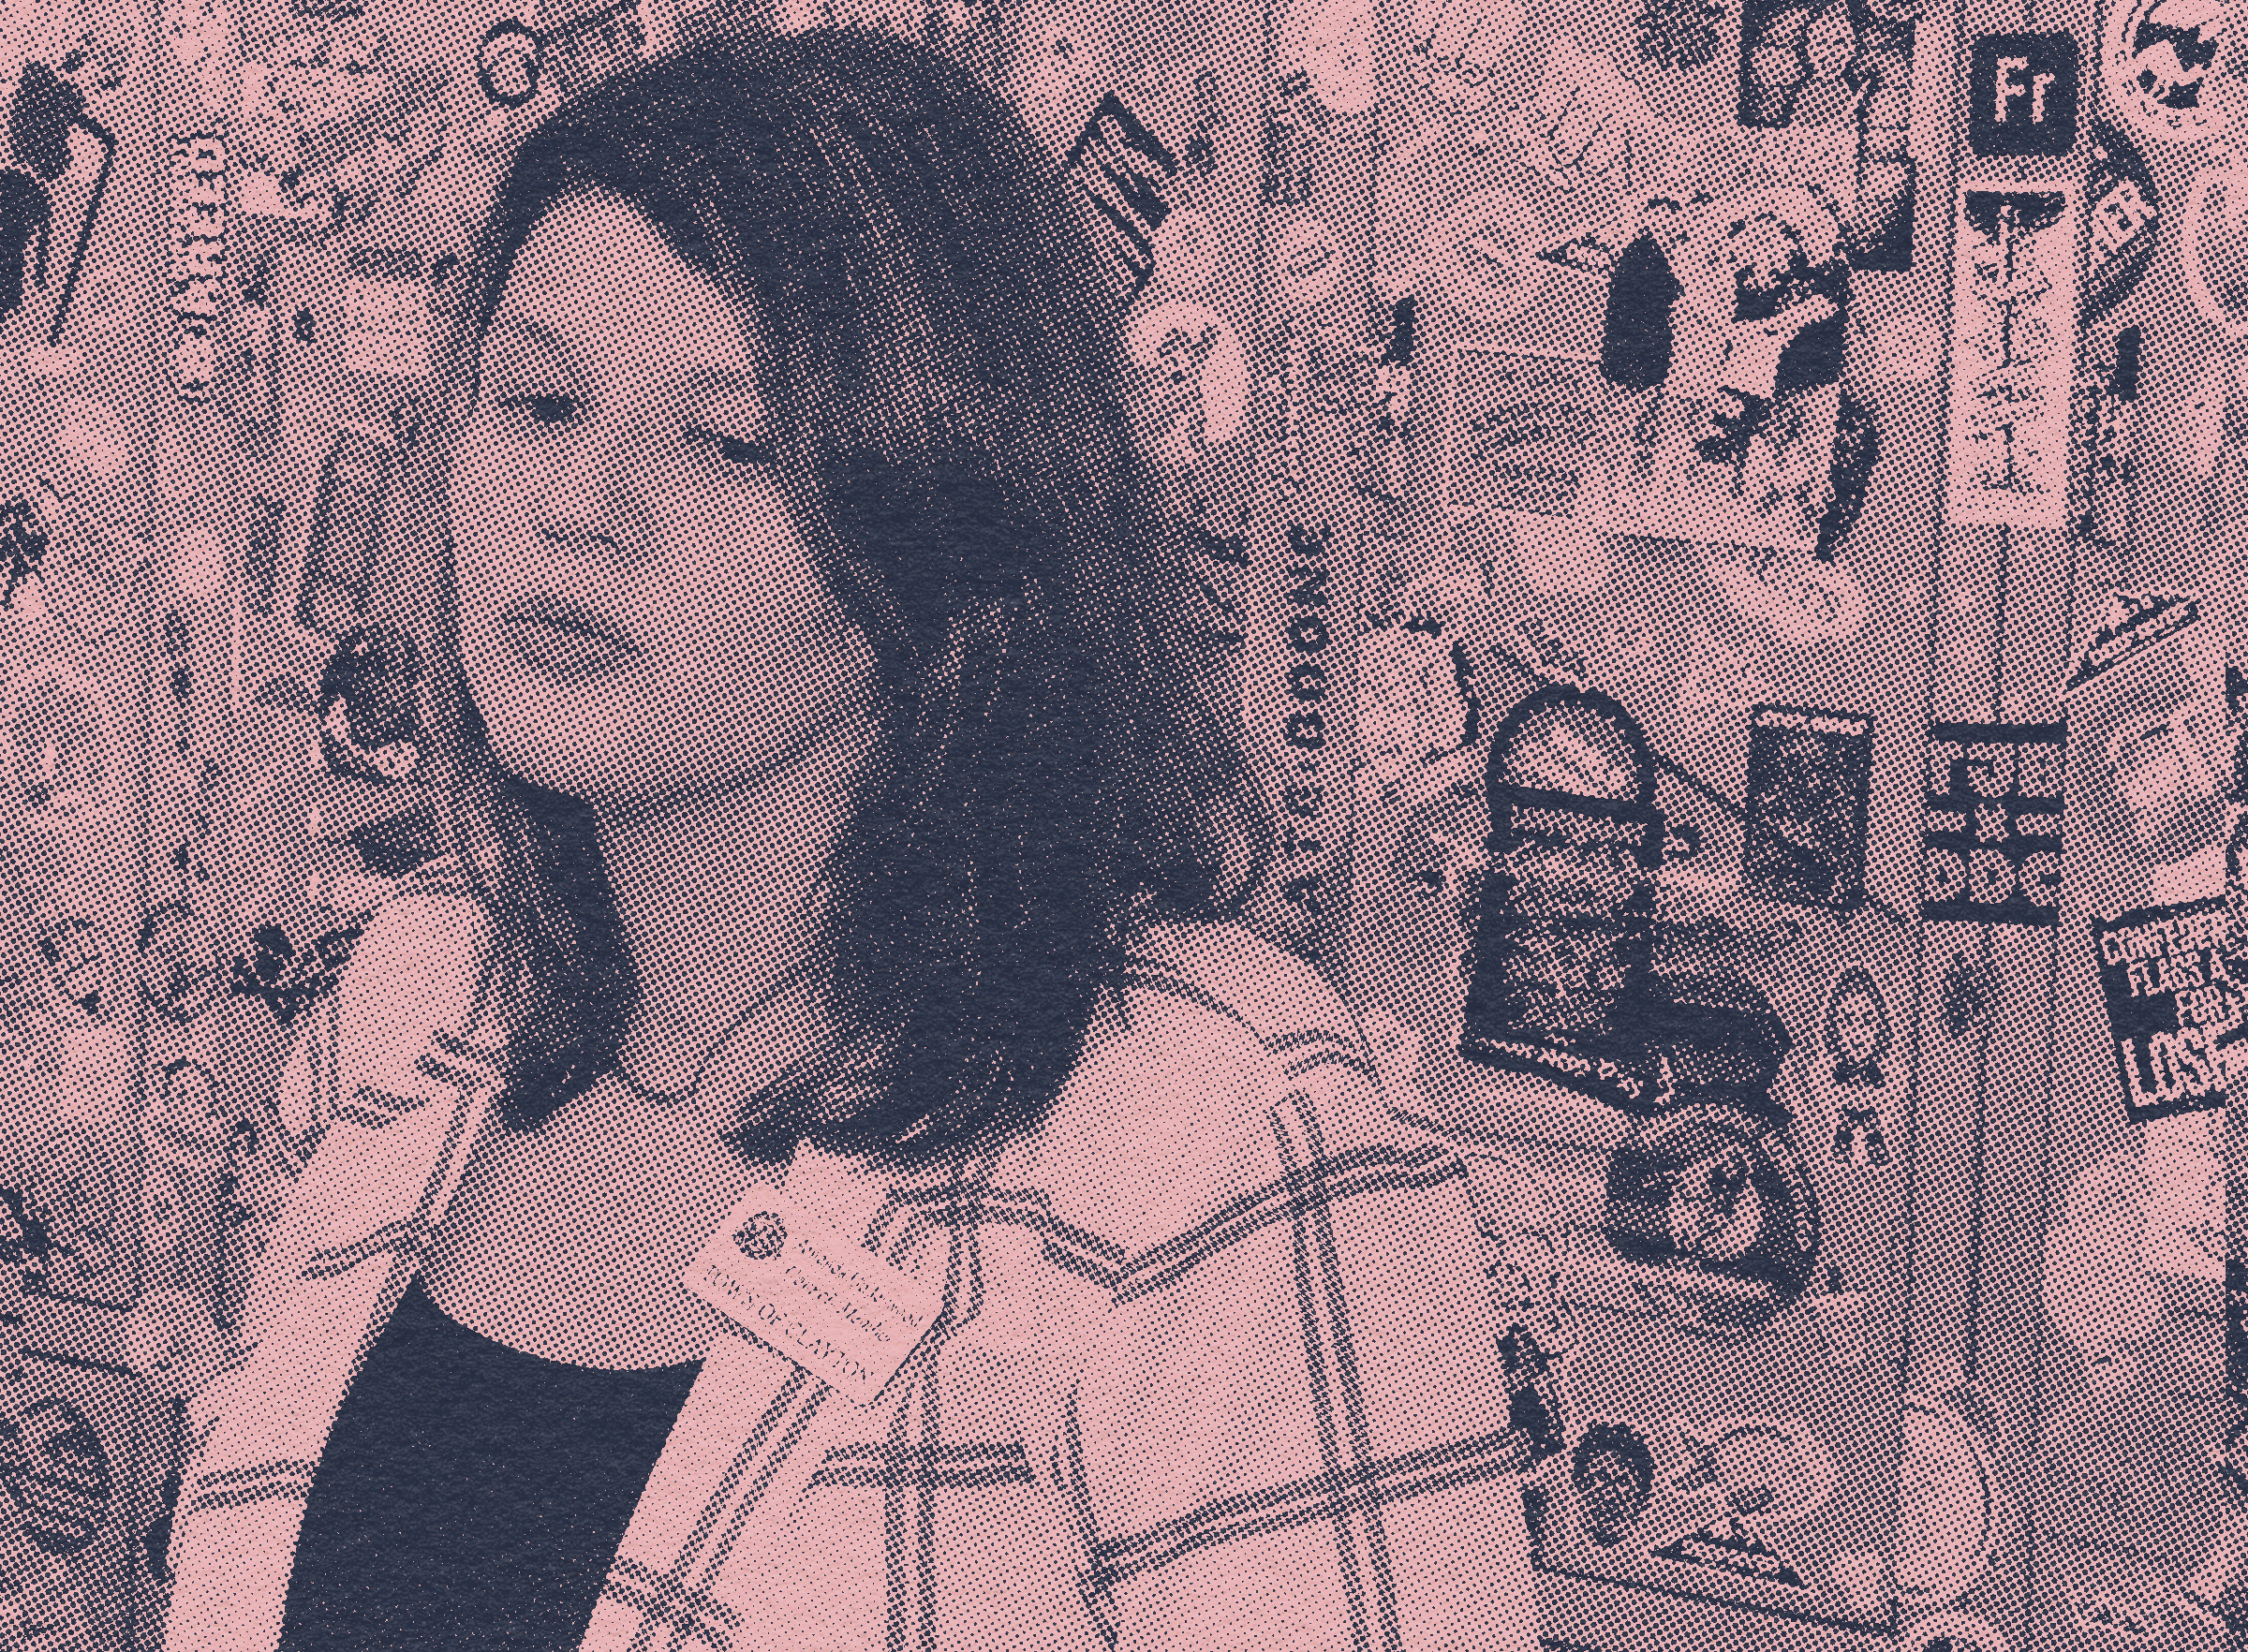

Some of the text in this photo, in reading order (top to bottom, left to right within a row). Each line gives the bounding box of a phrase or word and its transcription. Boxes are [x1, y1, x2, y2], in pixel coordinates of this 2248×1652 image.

[1995, 57, 2054, 124] Fr
[701, 1262, 875, 1389] TOWN OF CLAYTON
